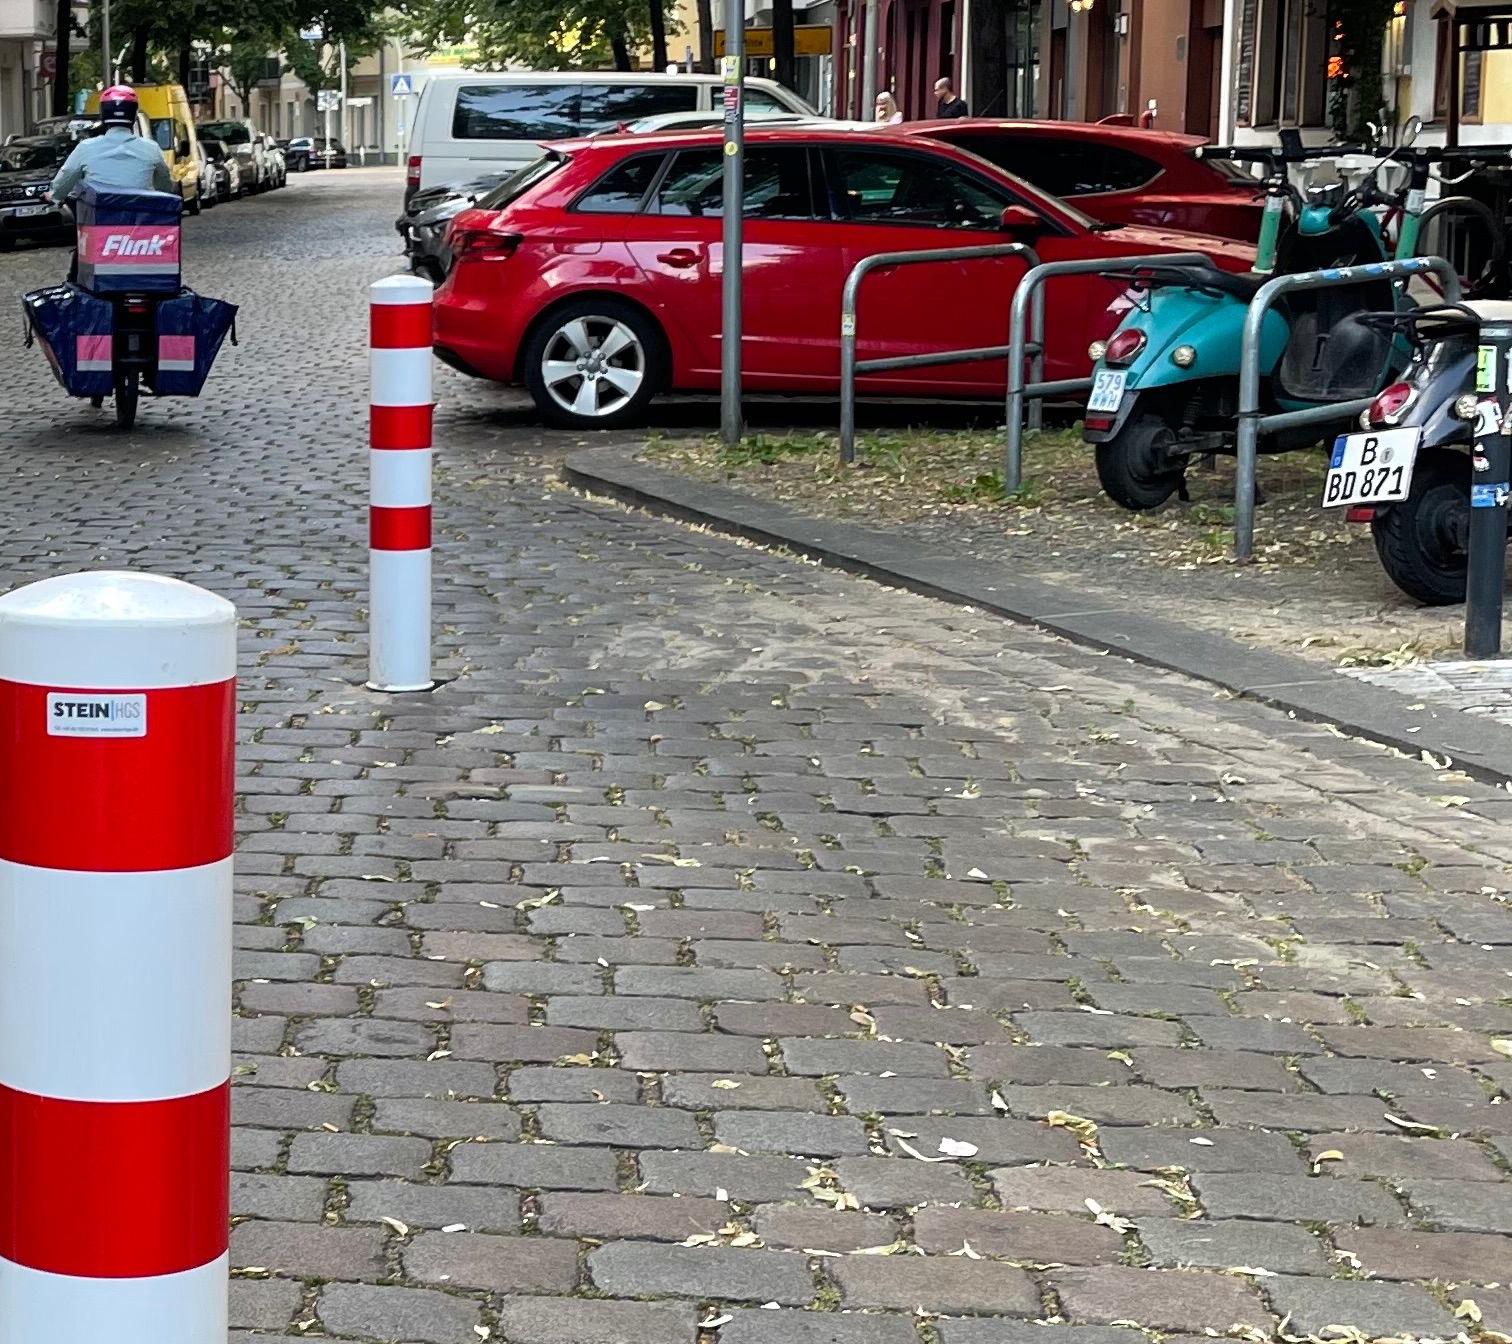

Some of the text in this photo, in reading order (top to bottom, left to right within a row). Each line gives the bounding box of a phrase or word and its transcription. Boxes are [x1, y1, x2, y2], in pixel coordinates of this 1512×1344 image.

[101, 234, 166, 256] Flink
[1096, 374, 1122, 390] 579
[1360, 434, 1378, 466] B
[1327, 466, 1404, 503] BD 871
[53, 702, 140, 718] STEIN HGS
